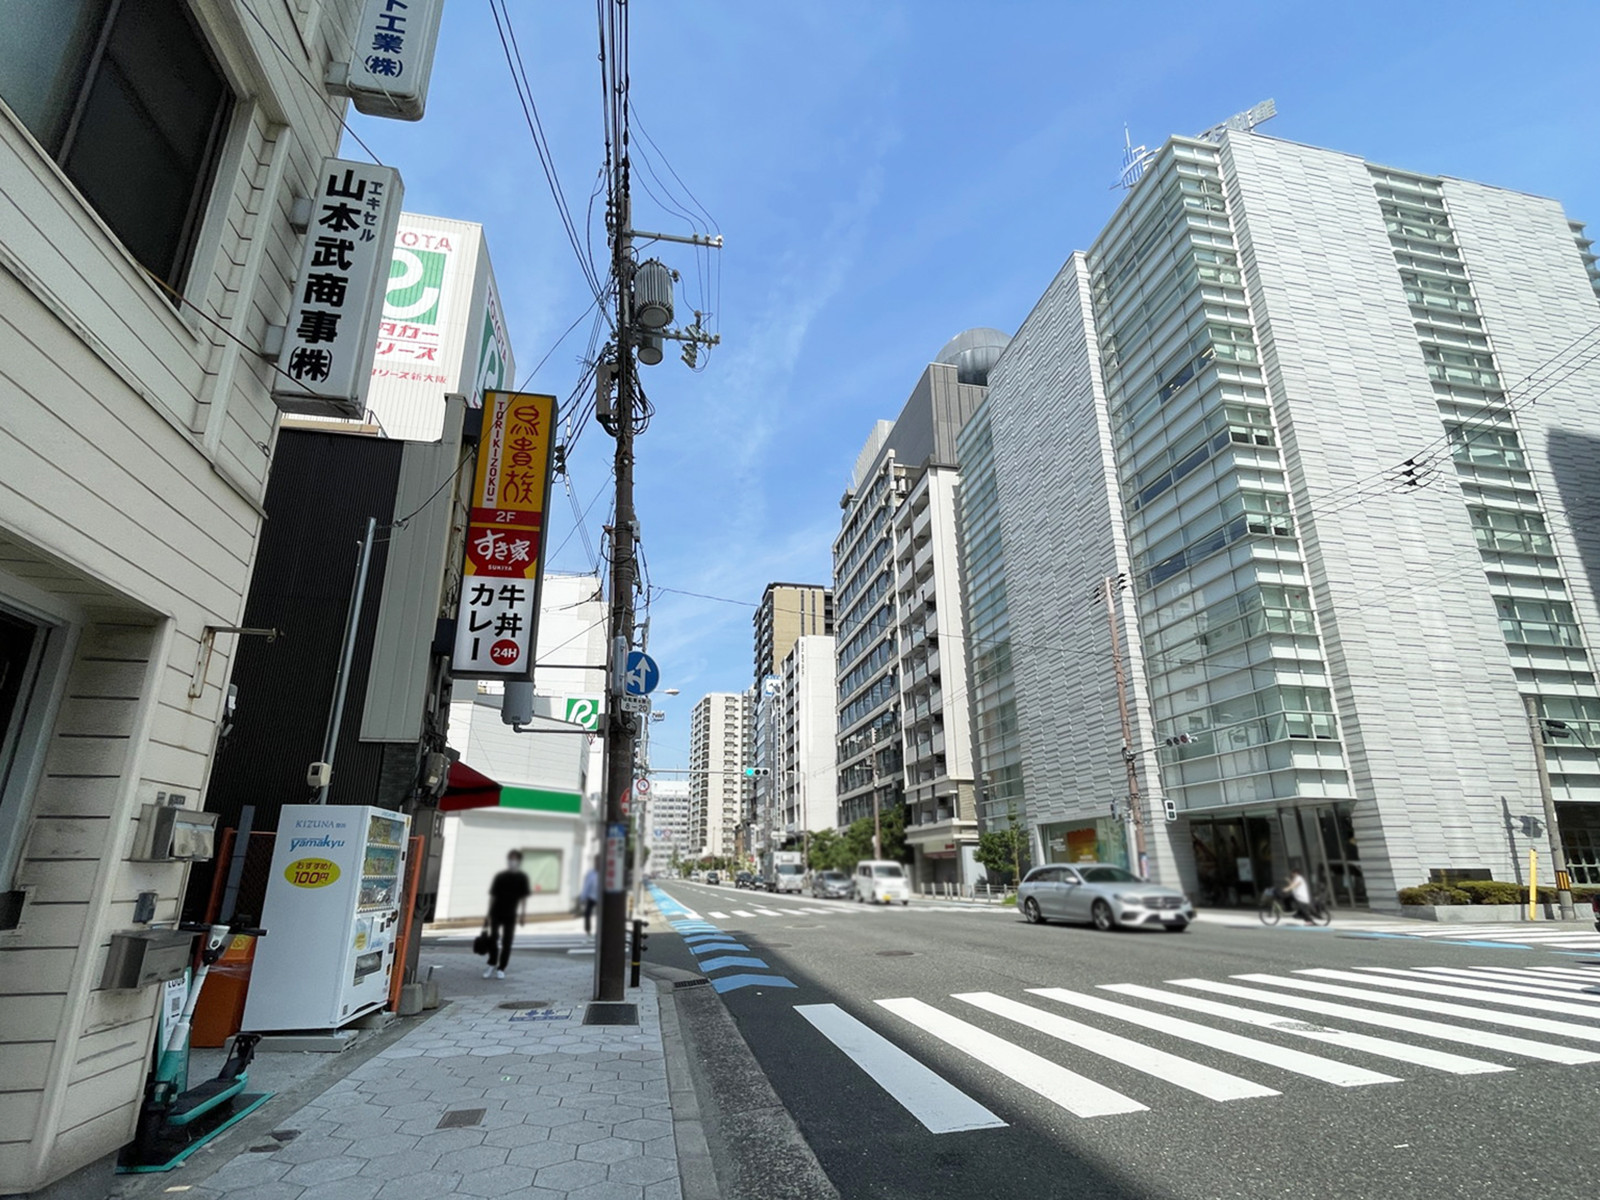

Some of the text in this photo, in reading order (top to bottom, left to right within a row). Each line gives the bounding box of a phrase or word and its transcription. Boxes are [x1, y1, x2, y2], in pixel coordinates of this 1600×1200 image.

[396, 230, 453, 252] OTA
[288, 169, 367, 384] 山本武商事(株)
[495, 511, 517, 523] 2F
[473, 529, 531, 565] すき家
[487, 564, 513, 572] SUKIYA
[494, 584, 526, 638] 牛丼
[468, 583, 495, 661] カレー
[492, 647, 518, 659] 24H
[295, 820, 334, 829] KIZUNA
[289, 834, 346, 853] yamakyu
[293, 870, 330, 885] 100円
